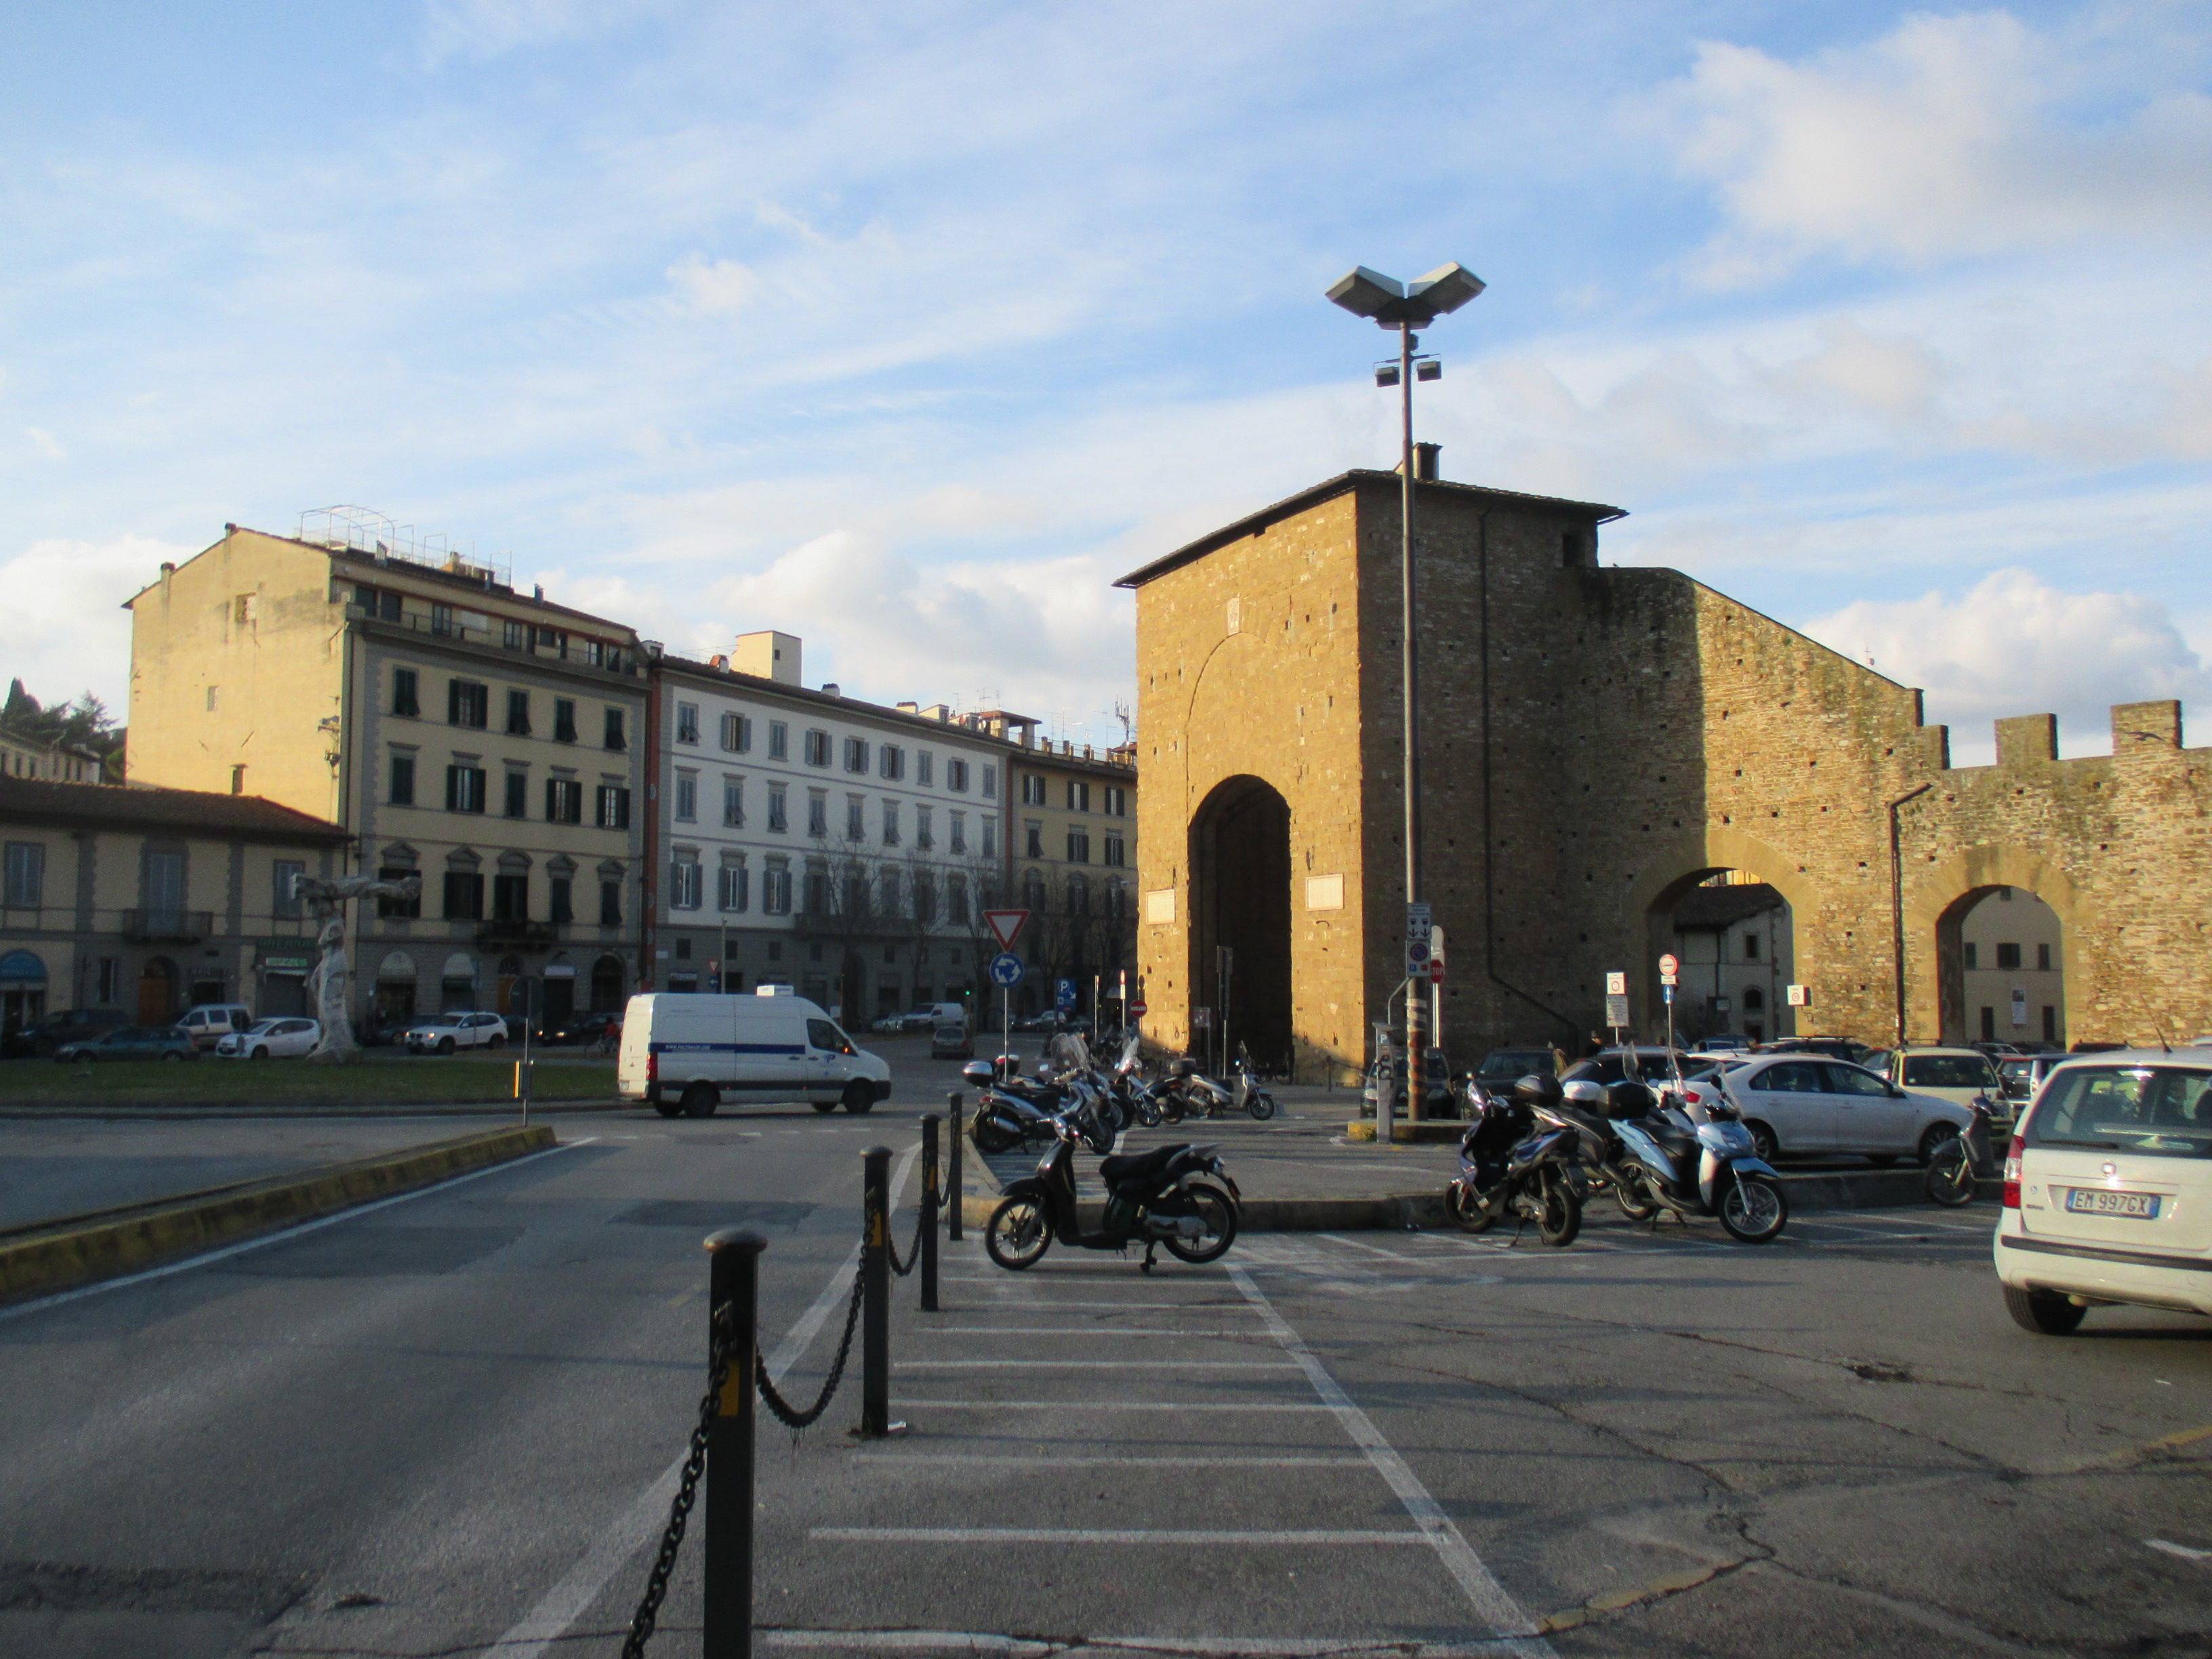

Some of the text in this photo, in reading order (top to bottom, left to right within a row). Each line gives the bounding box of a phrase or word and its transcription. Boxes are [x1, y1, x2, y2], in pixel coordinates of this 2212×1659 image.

[1431, 966, 1443, 976] TOP
[1061, 981, 1068, 992] P
[1380, 1034, 1387, 1044] P
[2075, 1191, 2148, 1214] EM 997GX
